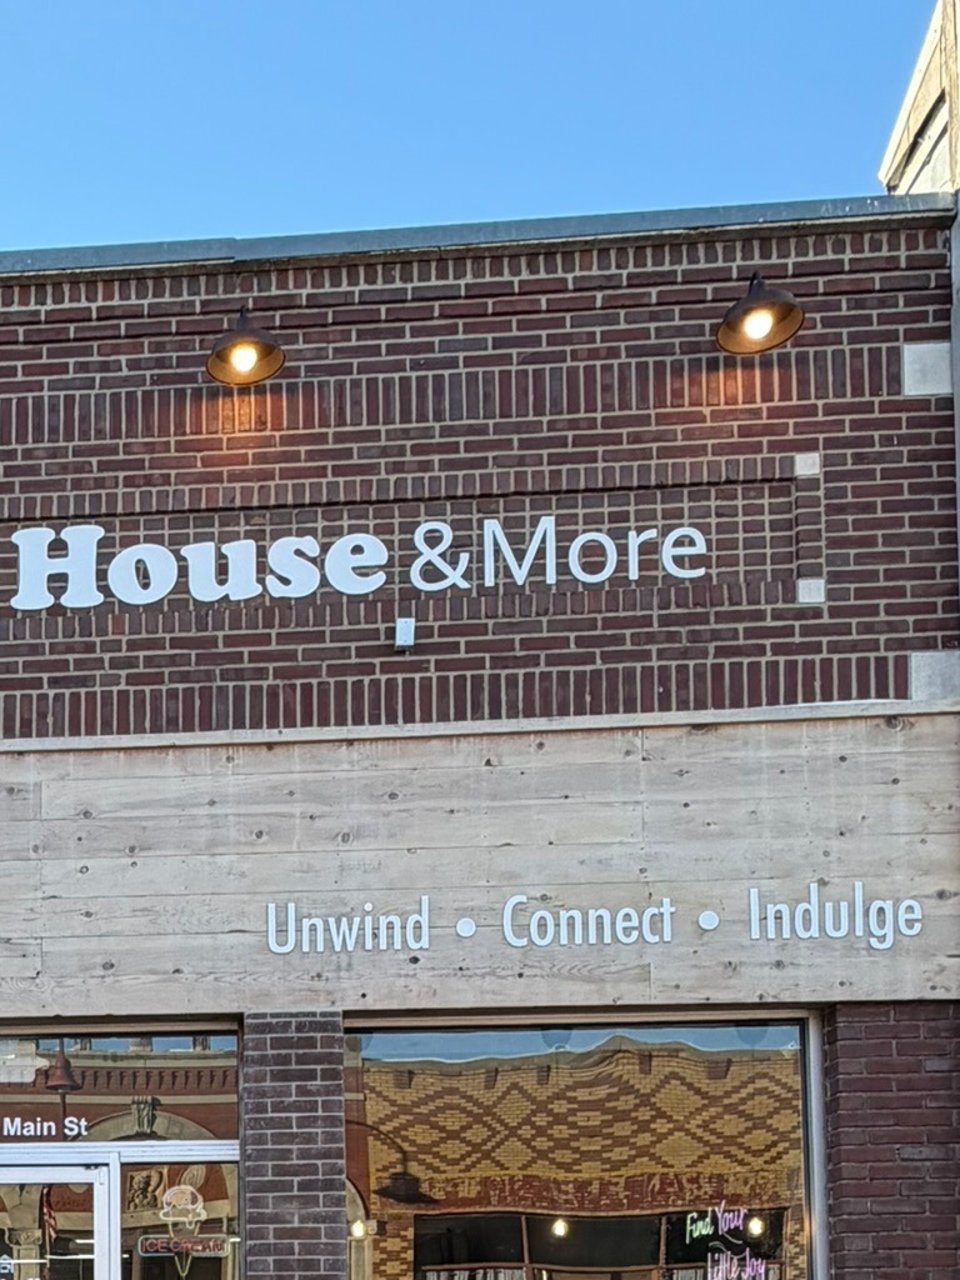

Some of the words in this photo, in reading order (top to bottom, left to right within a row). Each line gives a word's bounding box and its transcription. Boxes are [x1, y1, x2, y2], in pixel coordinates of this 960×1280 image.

[9, 523, 389, 611] House
[408, 515, 709, 593] &More
[265, 895, 430, 954] Unwind
[501, 893, 677, 948] Connect
[748, 880, 923, 951] Indulge
[2, 1116, 56, 1138] Main
[63, 1116, 88, 1137] St
[142, 1238, 168, 1252] ICE
[685, 1206, 714, 1245] Find
[715, 1199, 749, 1236] Your
